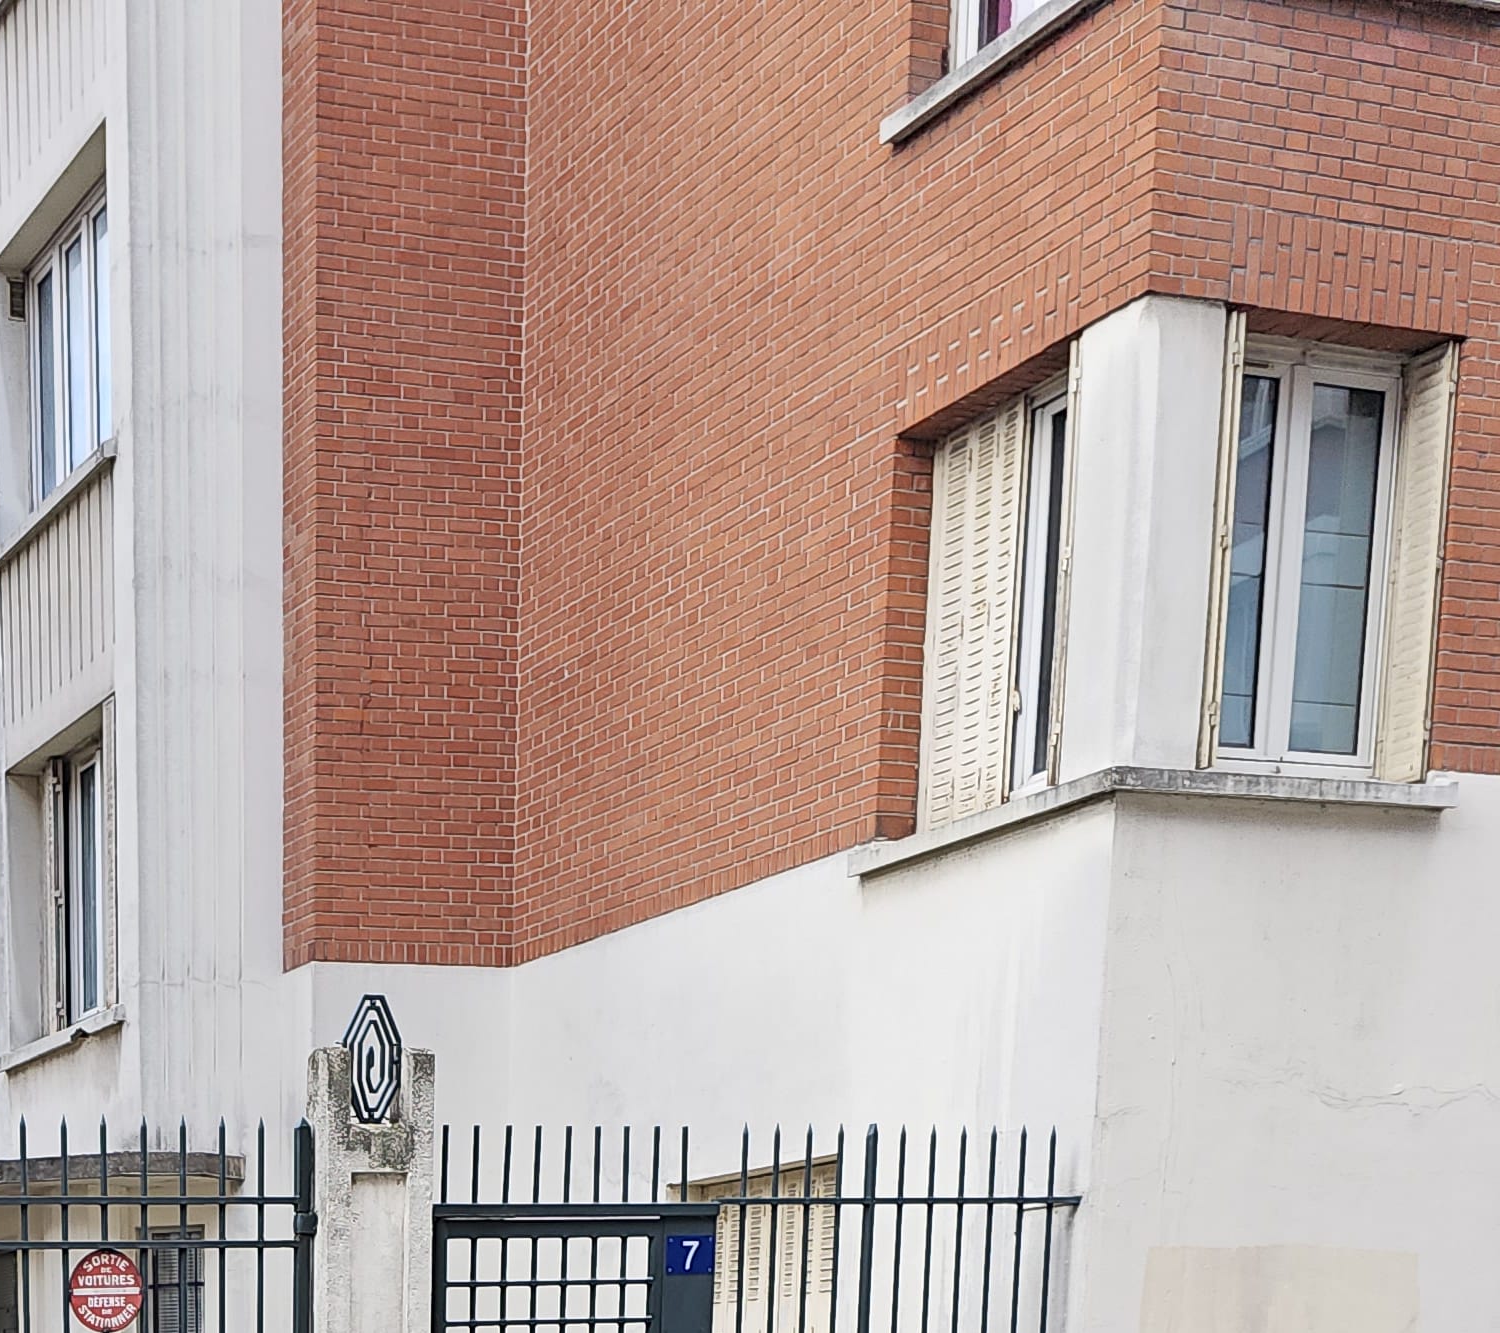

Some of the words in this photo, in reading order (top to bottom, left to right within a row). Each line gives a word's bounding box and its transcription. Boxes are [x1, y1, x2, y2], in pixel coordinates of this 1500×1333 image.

[82, 1253, 130, 1273] SORTIE
[682, 1240, 700, 1270] 7
[77, 1274, 135, 1286] VOITURES
[78, 1303, 137, 1328] STATIONNER
